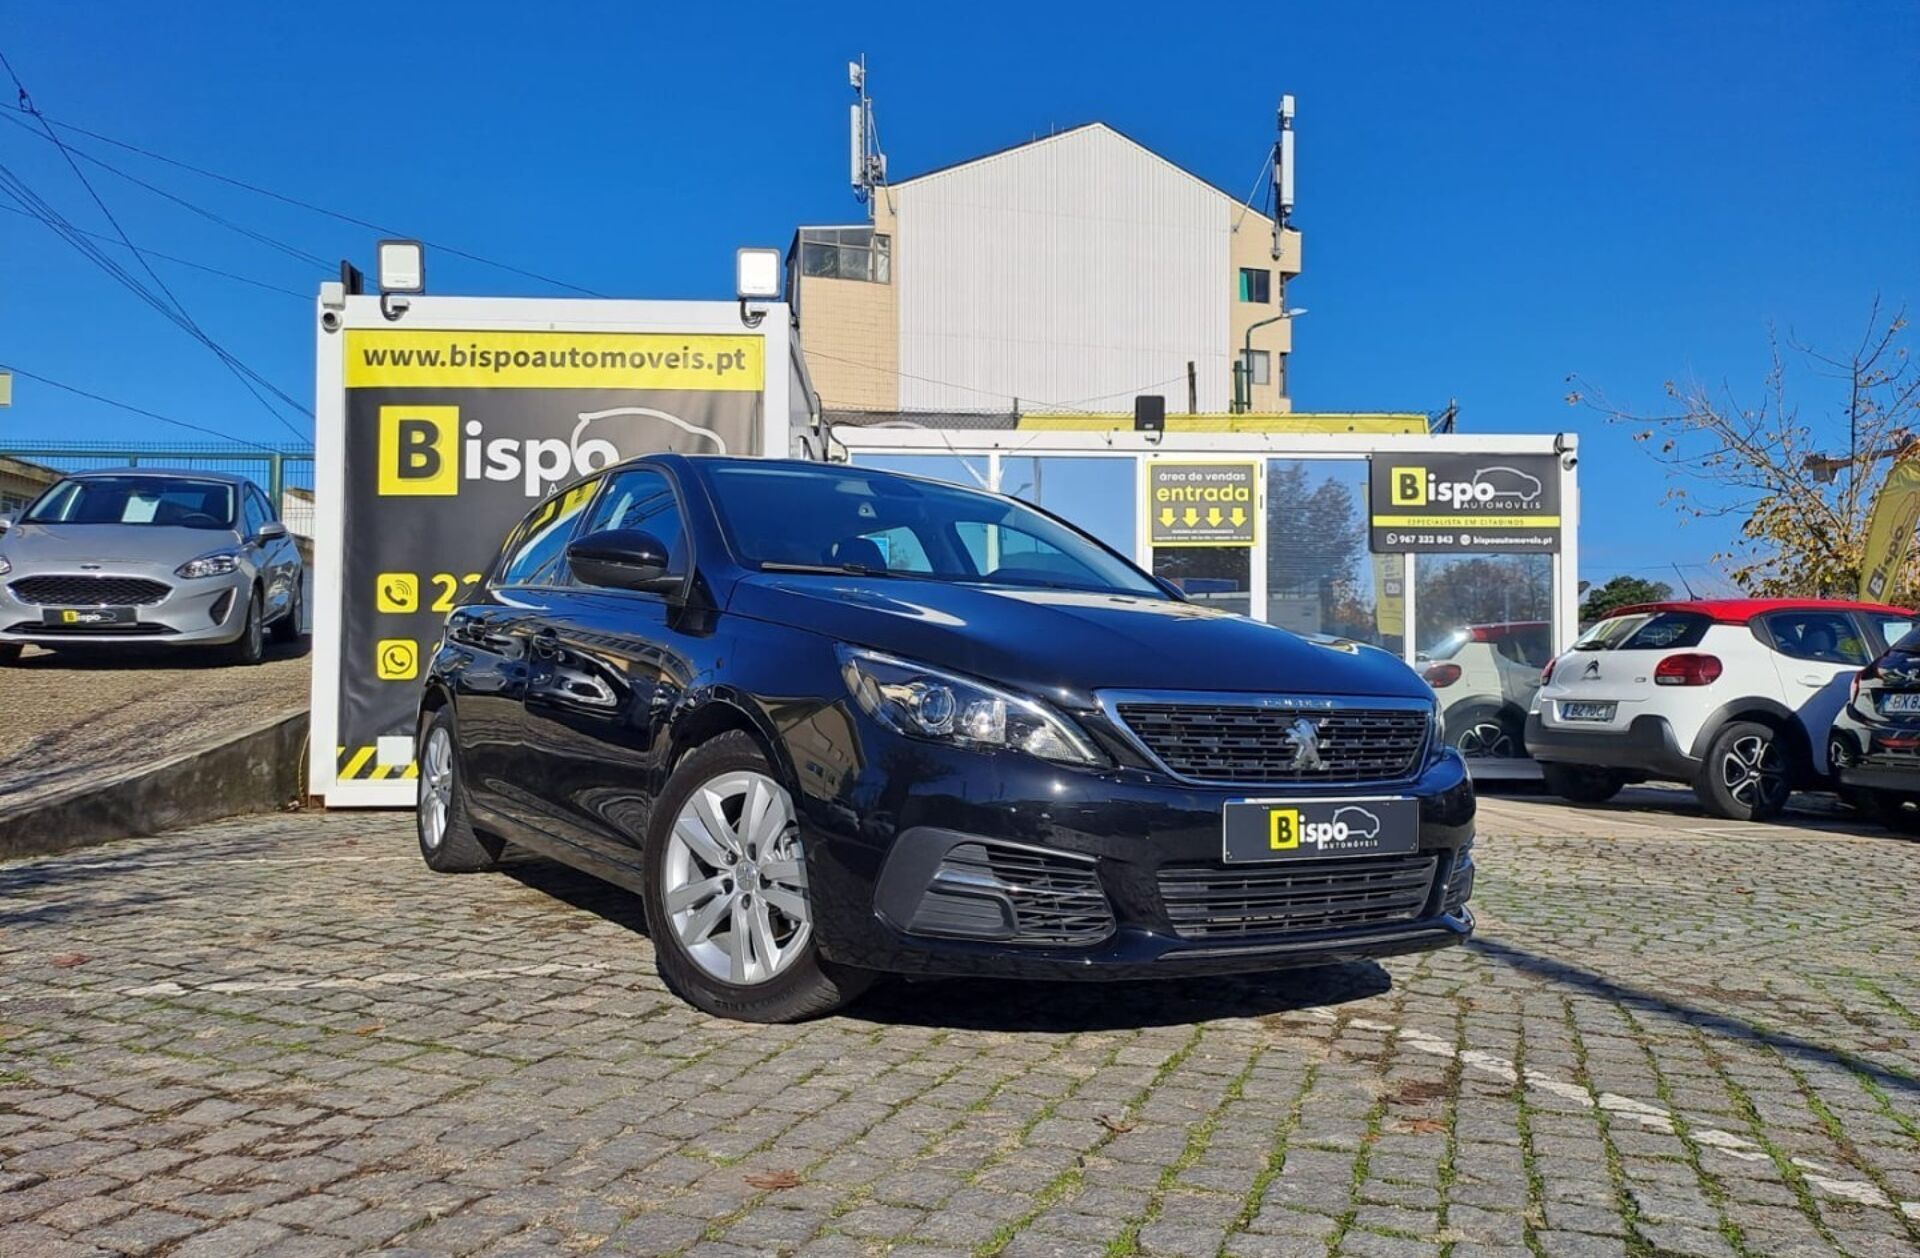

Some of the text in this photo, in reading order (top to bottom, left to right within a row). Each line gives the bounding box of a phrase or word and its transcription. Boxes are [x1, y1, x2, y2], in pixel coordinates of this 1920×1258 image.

[363, 344, 746, 374] www.bispoautomoveis.pt
[397, 419, 620, 497] Bispo
[1160, 472, 1246, 481] área de vendas
[1156, 483, 1249, 501] entrada
[1400, 473, 1496, 509] Bispo
[1462, 499, 1541, 509] AUTOMÓVEIS
[1407, 518, 1525, 526] ESPECIALISTA EM CITADINOS
[1399, 535, 1416, 544] 967
[1277, 815, 1349, 850] Bispo
